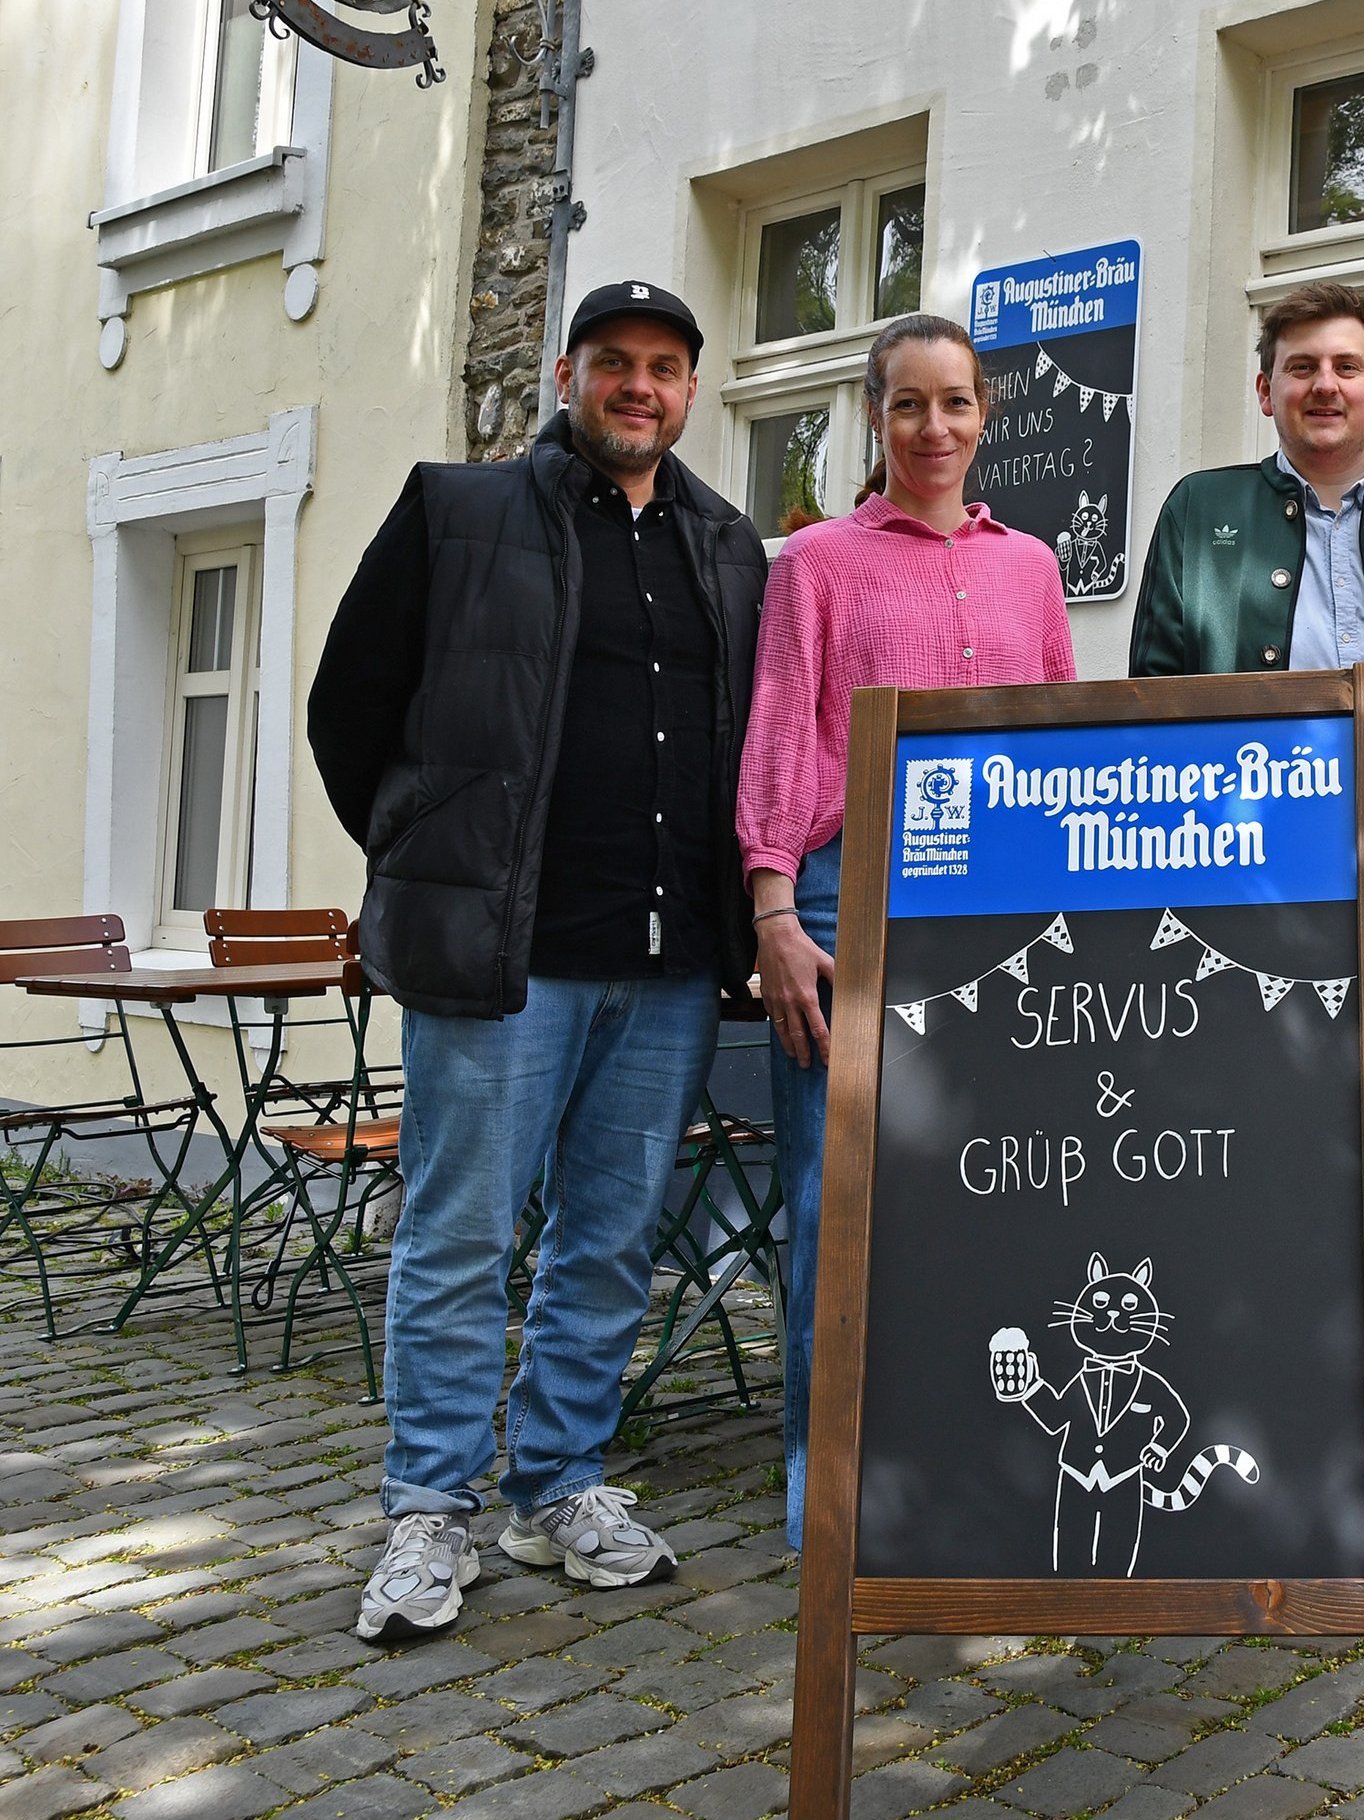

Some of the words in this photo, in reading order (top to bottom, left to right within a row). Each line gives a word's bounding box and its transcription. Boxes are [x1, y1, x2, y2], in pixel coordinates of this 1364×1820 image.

[1030, 297, 1105, 333] München
[979, 416, 1010, 446] WIR
[1018, 408, 1055, 438] UNS
[977, 447, 1076, 492] VATERTAG
[1060, 809, 1266, 872] München
[902, 864, 947, 879] gegründet
[948, 863, 968, 876] 1328
[1010, 978, 1200, 1050] SERVUS
[1096, 1070, 1136, 1118] &
[1112, 1128, 1236, 1183] GOTT
